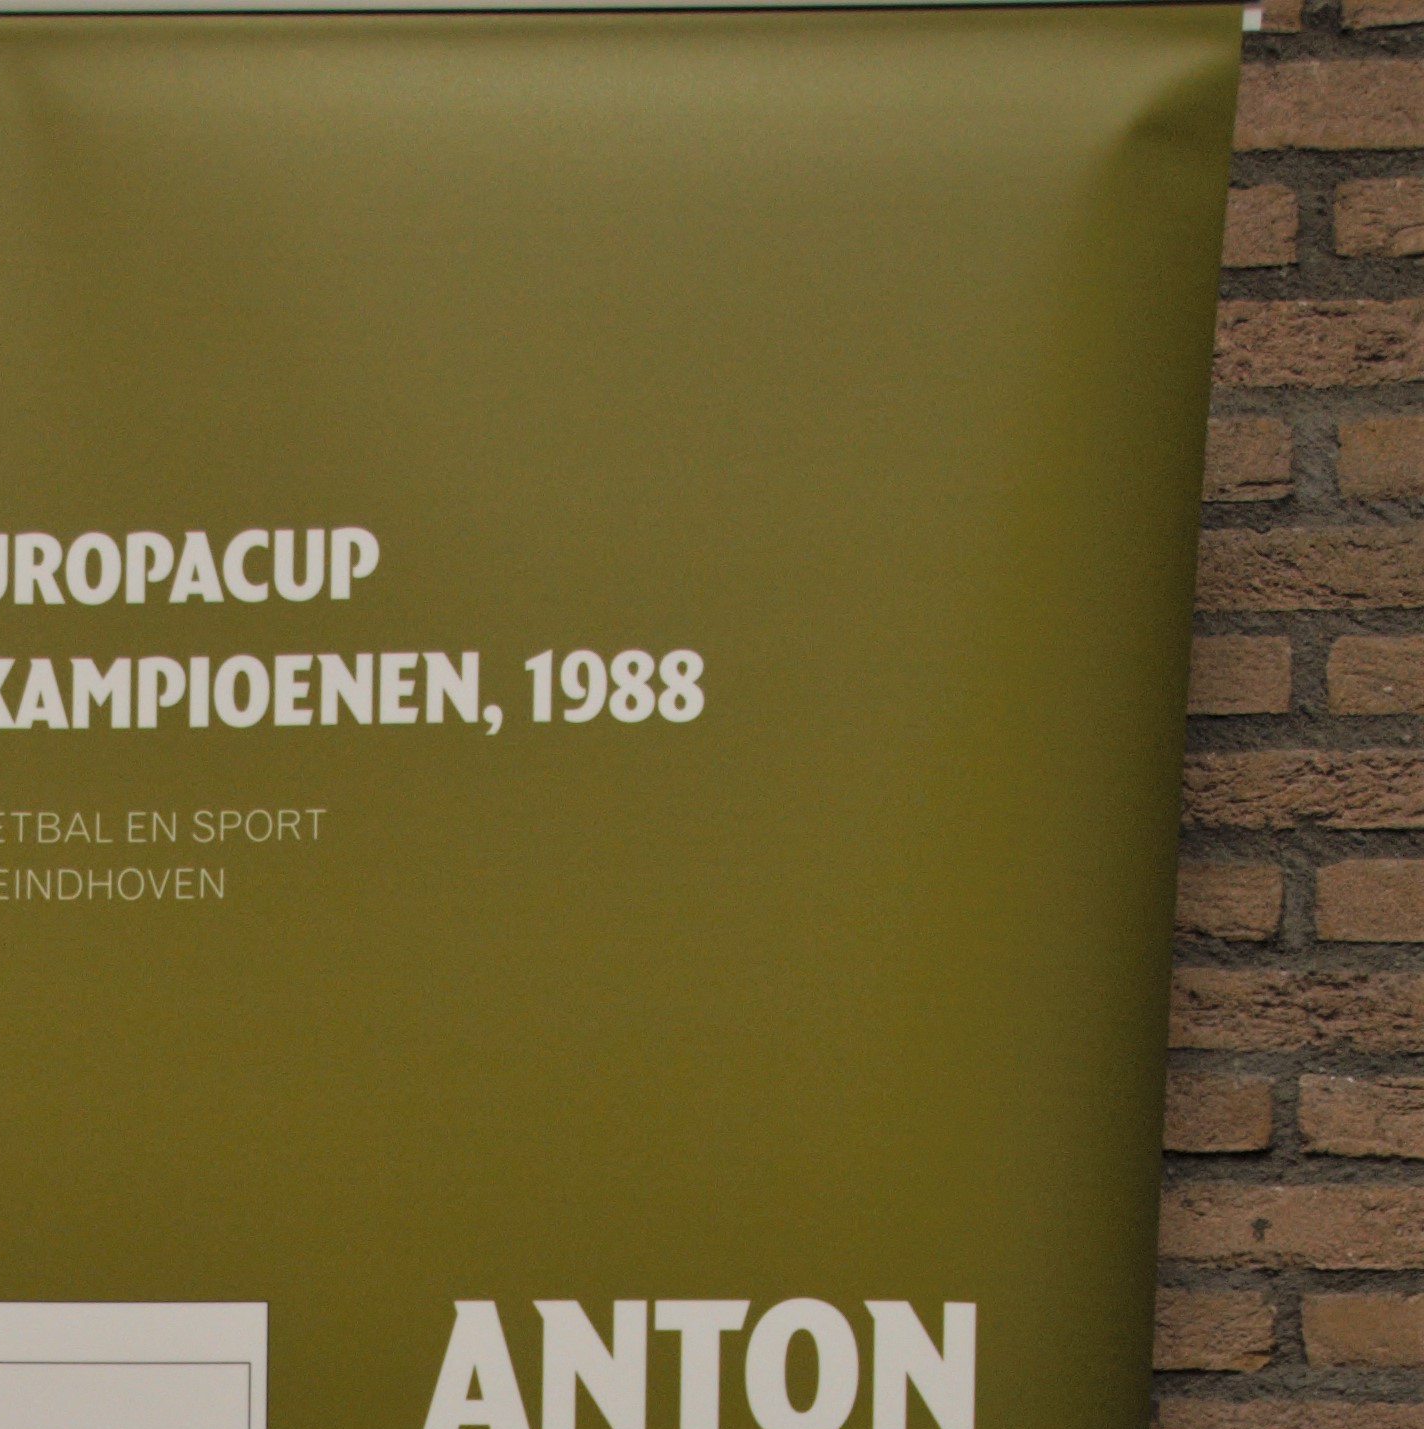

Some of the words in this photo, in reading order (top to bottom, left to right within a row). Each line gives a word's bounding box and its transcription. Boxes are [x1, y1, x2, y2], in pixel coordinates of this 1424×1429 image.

[524, 649, 705, 723] 1988
[127, 811, 177, 843] EN
[192, 808, 326, 843] SPORT
